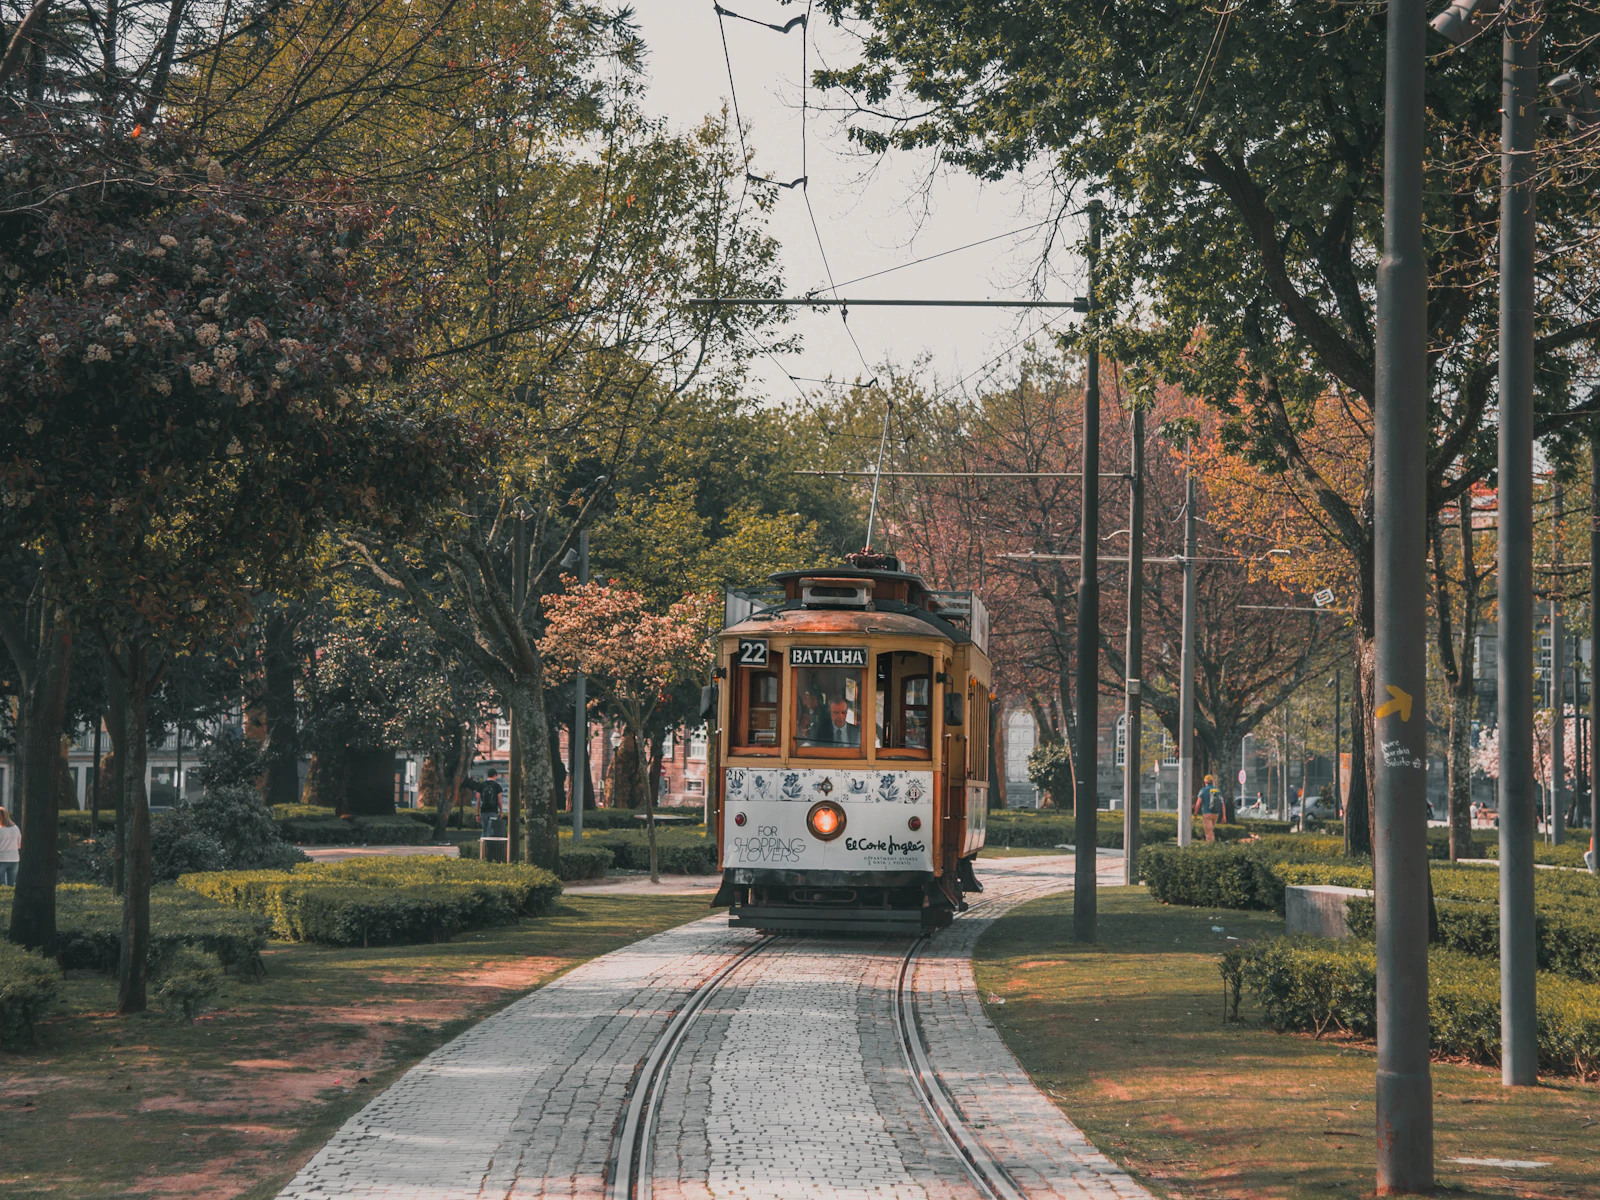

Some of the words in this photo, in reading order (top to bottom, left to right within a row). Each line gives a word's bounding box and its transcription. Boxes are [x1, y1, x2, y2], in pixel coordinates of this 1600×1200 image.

[740, 642, 765, 663] 22
[792, 649, 863, 664] BATALHA
[727, 769, 744, 781] 218
[757, 825, 778, 837] FOR
[733, 837, 806, 853] SHOPPING
[845, 837, 858, 851] El
[858, 838, 887, 851] Corte
[888, 835, 925, 855] Inglés
[739, 847, 800, 863] LOVERS
